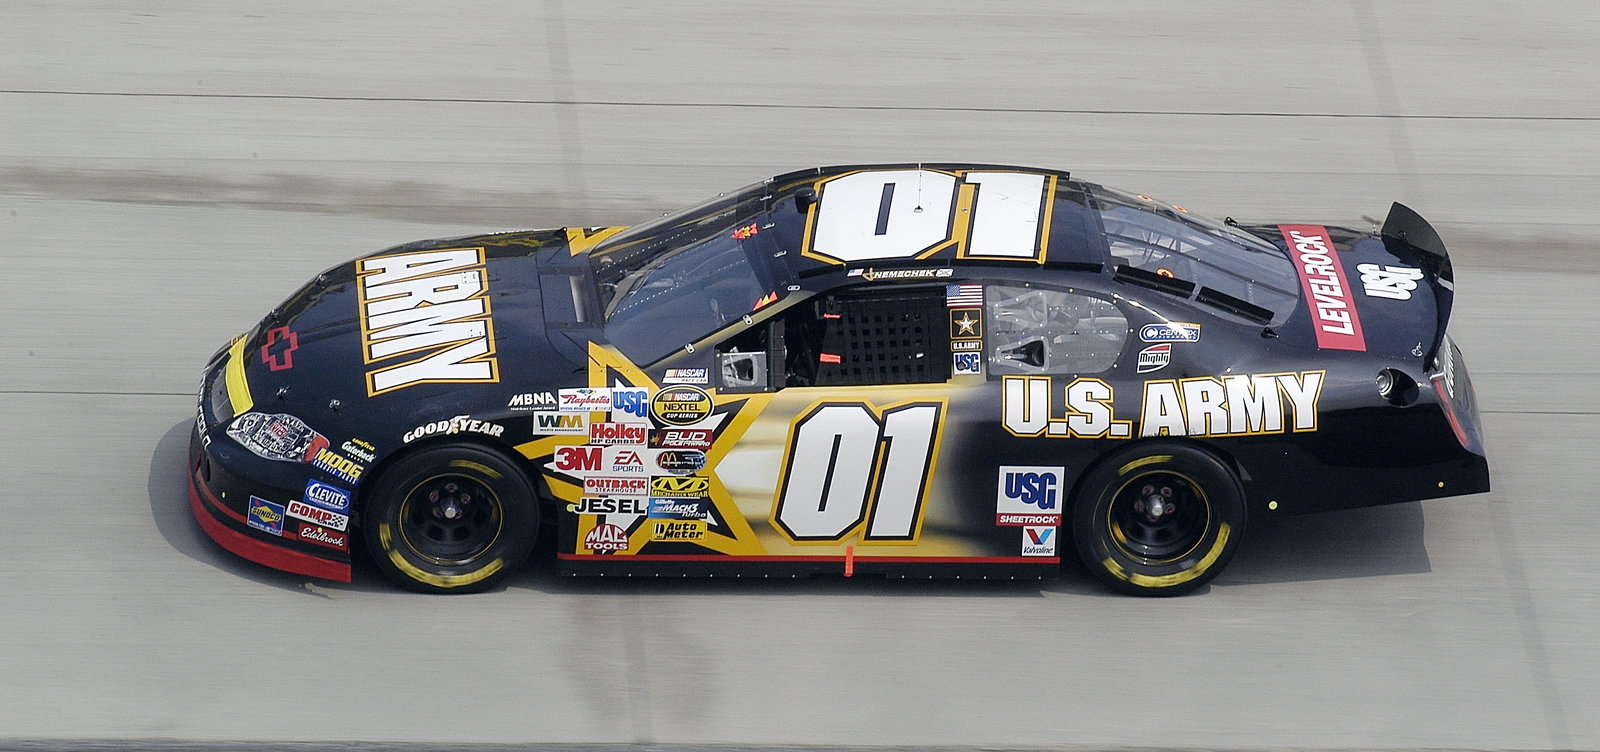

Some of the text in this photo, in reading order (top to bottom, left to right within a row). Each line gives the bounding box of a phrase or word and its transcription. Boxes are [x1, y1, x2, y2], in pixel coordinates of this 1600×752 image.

[811, 168, 1047, 262] 01
[874, 269, 934, 279] NEMECHEK
[1356, 262, 1425, 301] USG
[1291, 232, 1355, 336] LEVELROCK
[359, 248, 496, 395] ARMY
[955, 353, 980, 373] USG
[1140, 351, 1169, 364] Mighty
[677, 368, 705, 378] NASCAR
[508, 391, 557, 406] MBNA
[613, 391, 647, 418] USG
[674, 393, 700, 401] NASCAR
[1003, 370, 1325, 438] U.S. ARMY
[663, 403, 701, 411] NEXTEL
[403, 417, 504, 443] GOODYEAR
[538, 415, 583, 428] WM
[591, 423, 646, 444] Holley
[664, 431, 707, 441] BUD
[314, 447, 364, 479] MOOG
[555, 447, 603, 471] 3M
[614, 451, 644, 465] EA
[776, 402, 943, 541] 01
[586, 480, 646, 489] OUTBACK
[1005, 472, 1057, 510] USG
[308, 483, 347, 506] CLEVITE
[687, 490, 709, 498] WEAR
[252, 506, 281, 522] SUNOCO
[290, 502, 333, 522] COMP
[574, 498, 646, 514] JESEL
[666, 522, 698, 531] Auto
[999, 515, 1058, 524] SHEETROCK
[300, 527, 344, 547] Edelbrock
[585, 524, 628, 542] MAC
[662, 530, 704, 540] Meter
[585, 542, 628, 550] TOOLS
